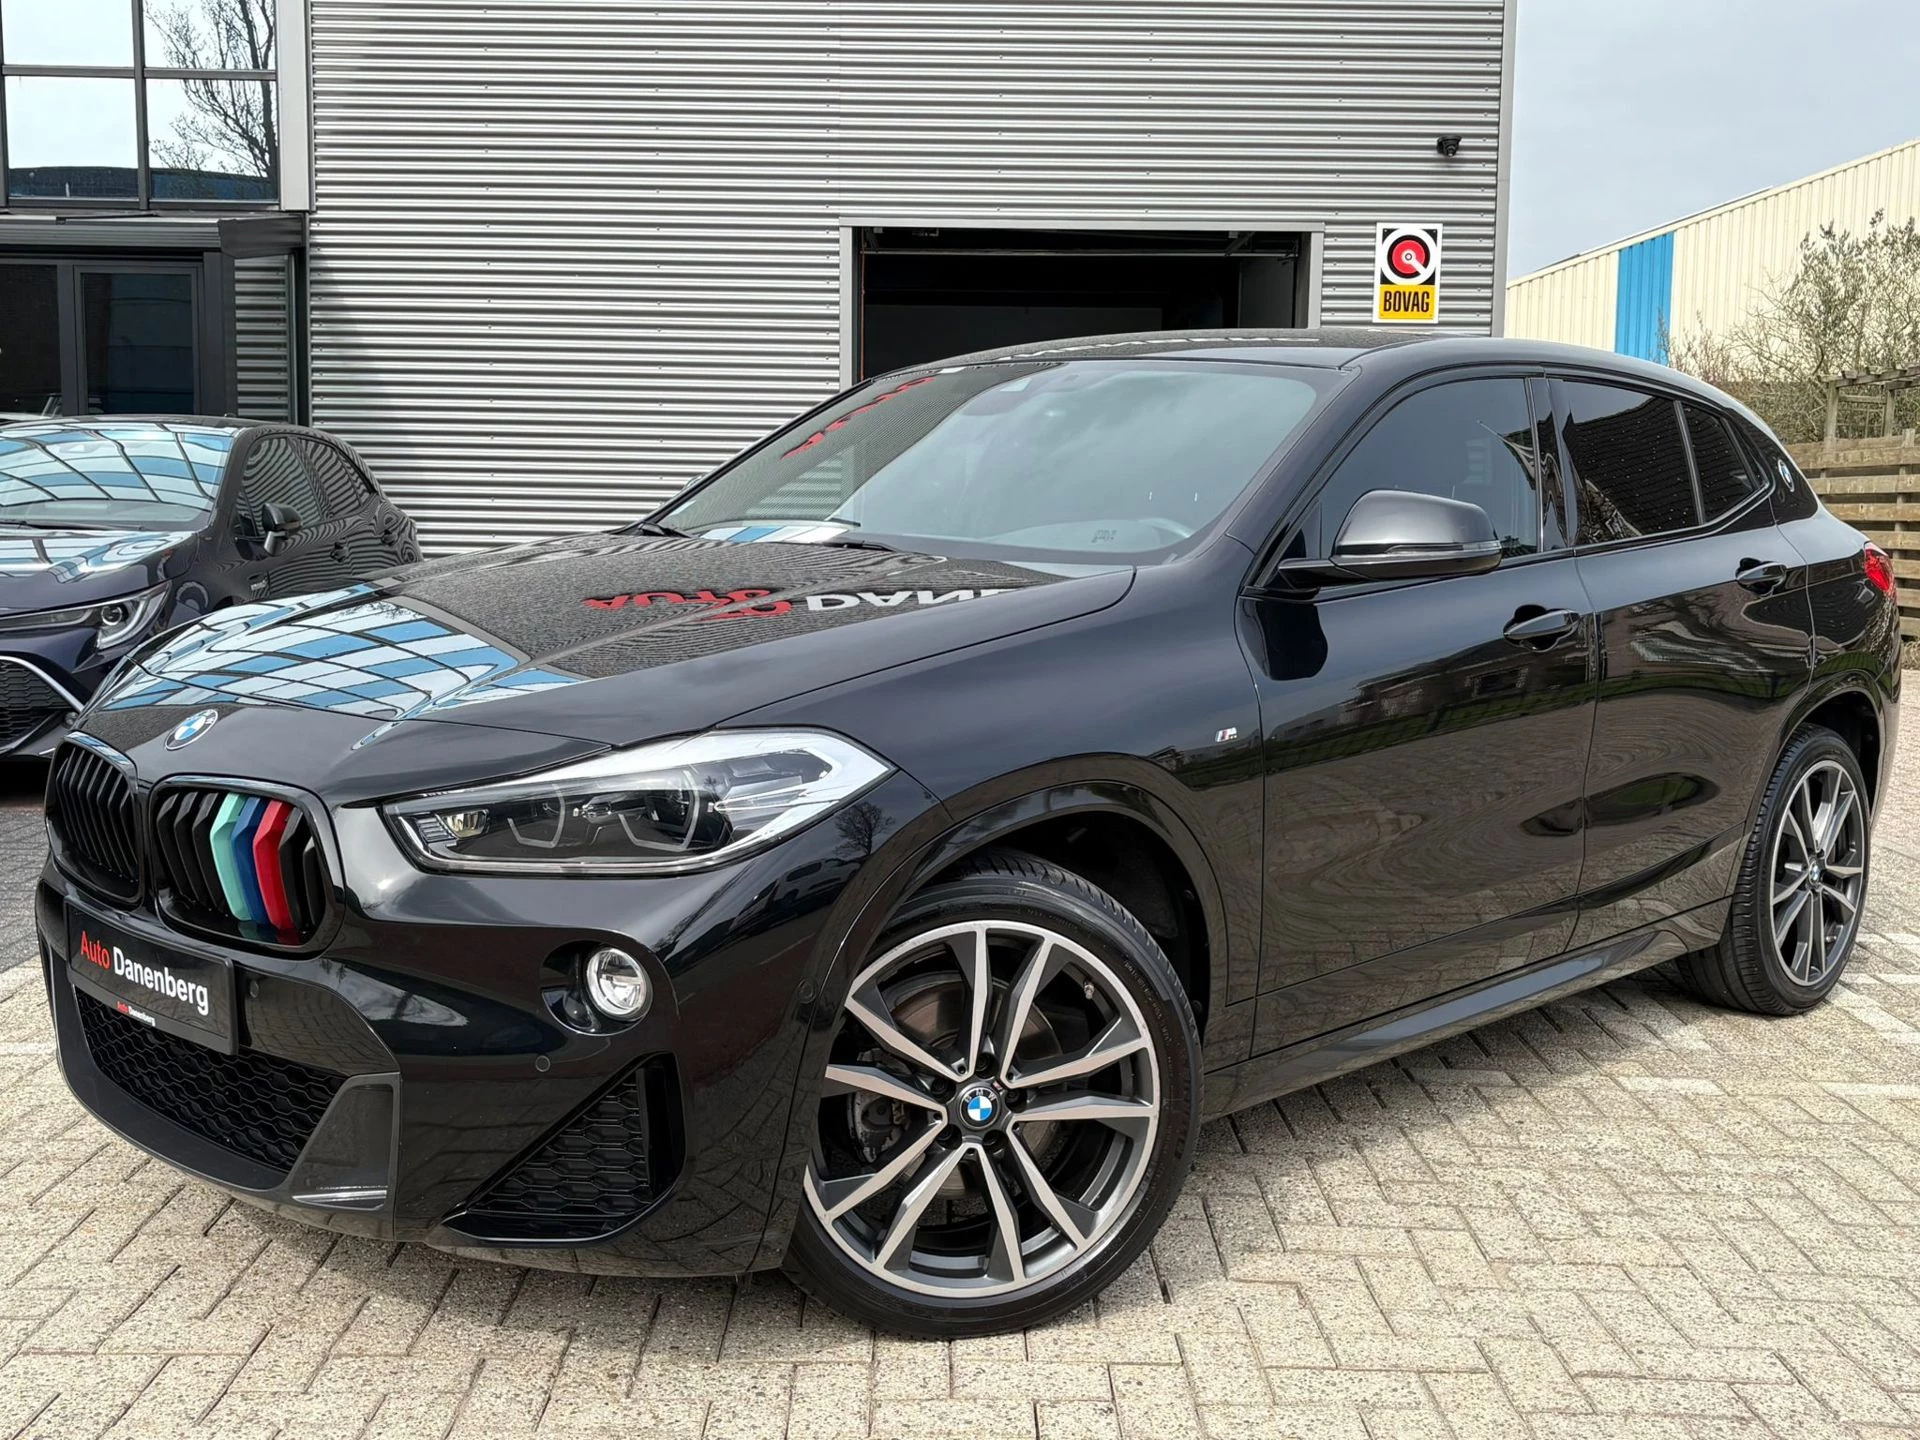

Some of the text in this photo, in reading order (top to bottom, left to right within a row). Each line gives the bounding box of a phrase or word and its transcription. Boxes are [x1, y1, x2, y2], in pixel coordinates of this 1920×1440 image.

[1383, 290, 1430, 313] BOVAG
[80, 930, 209, 1016] Auto Danenberg
